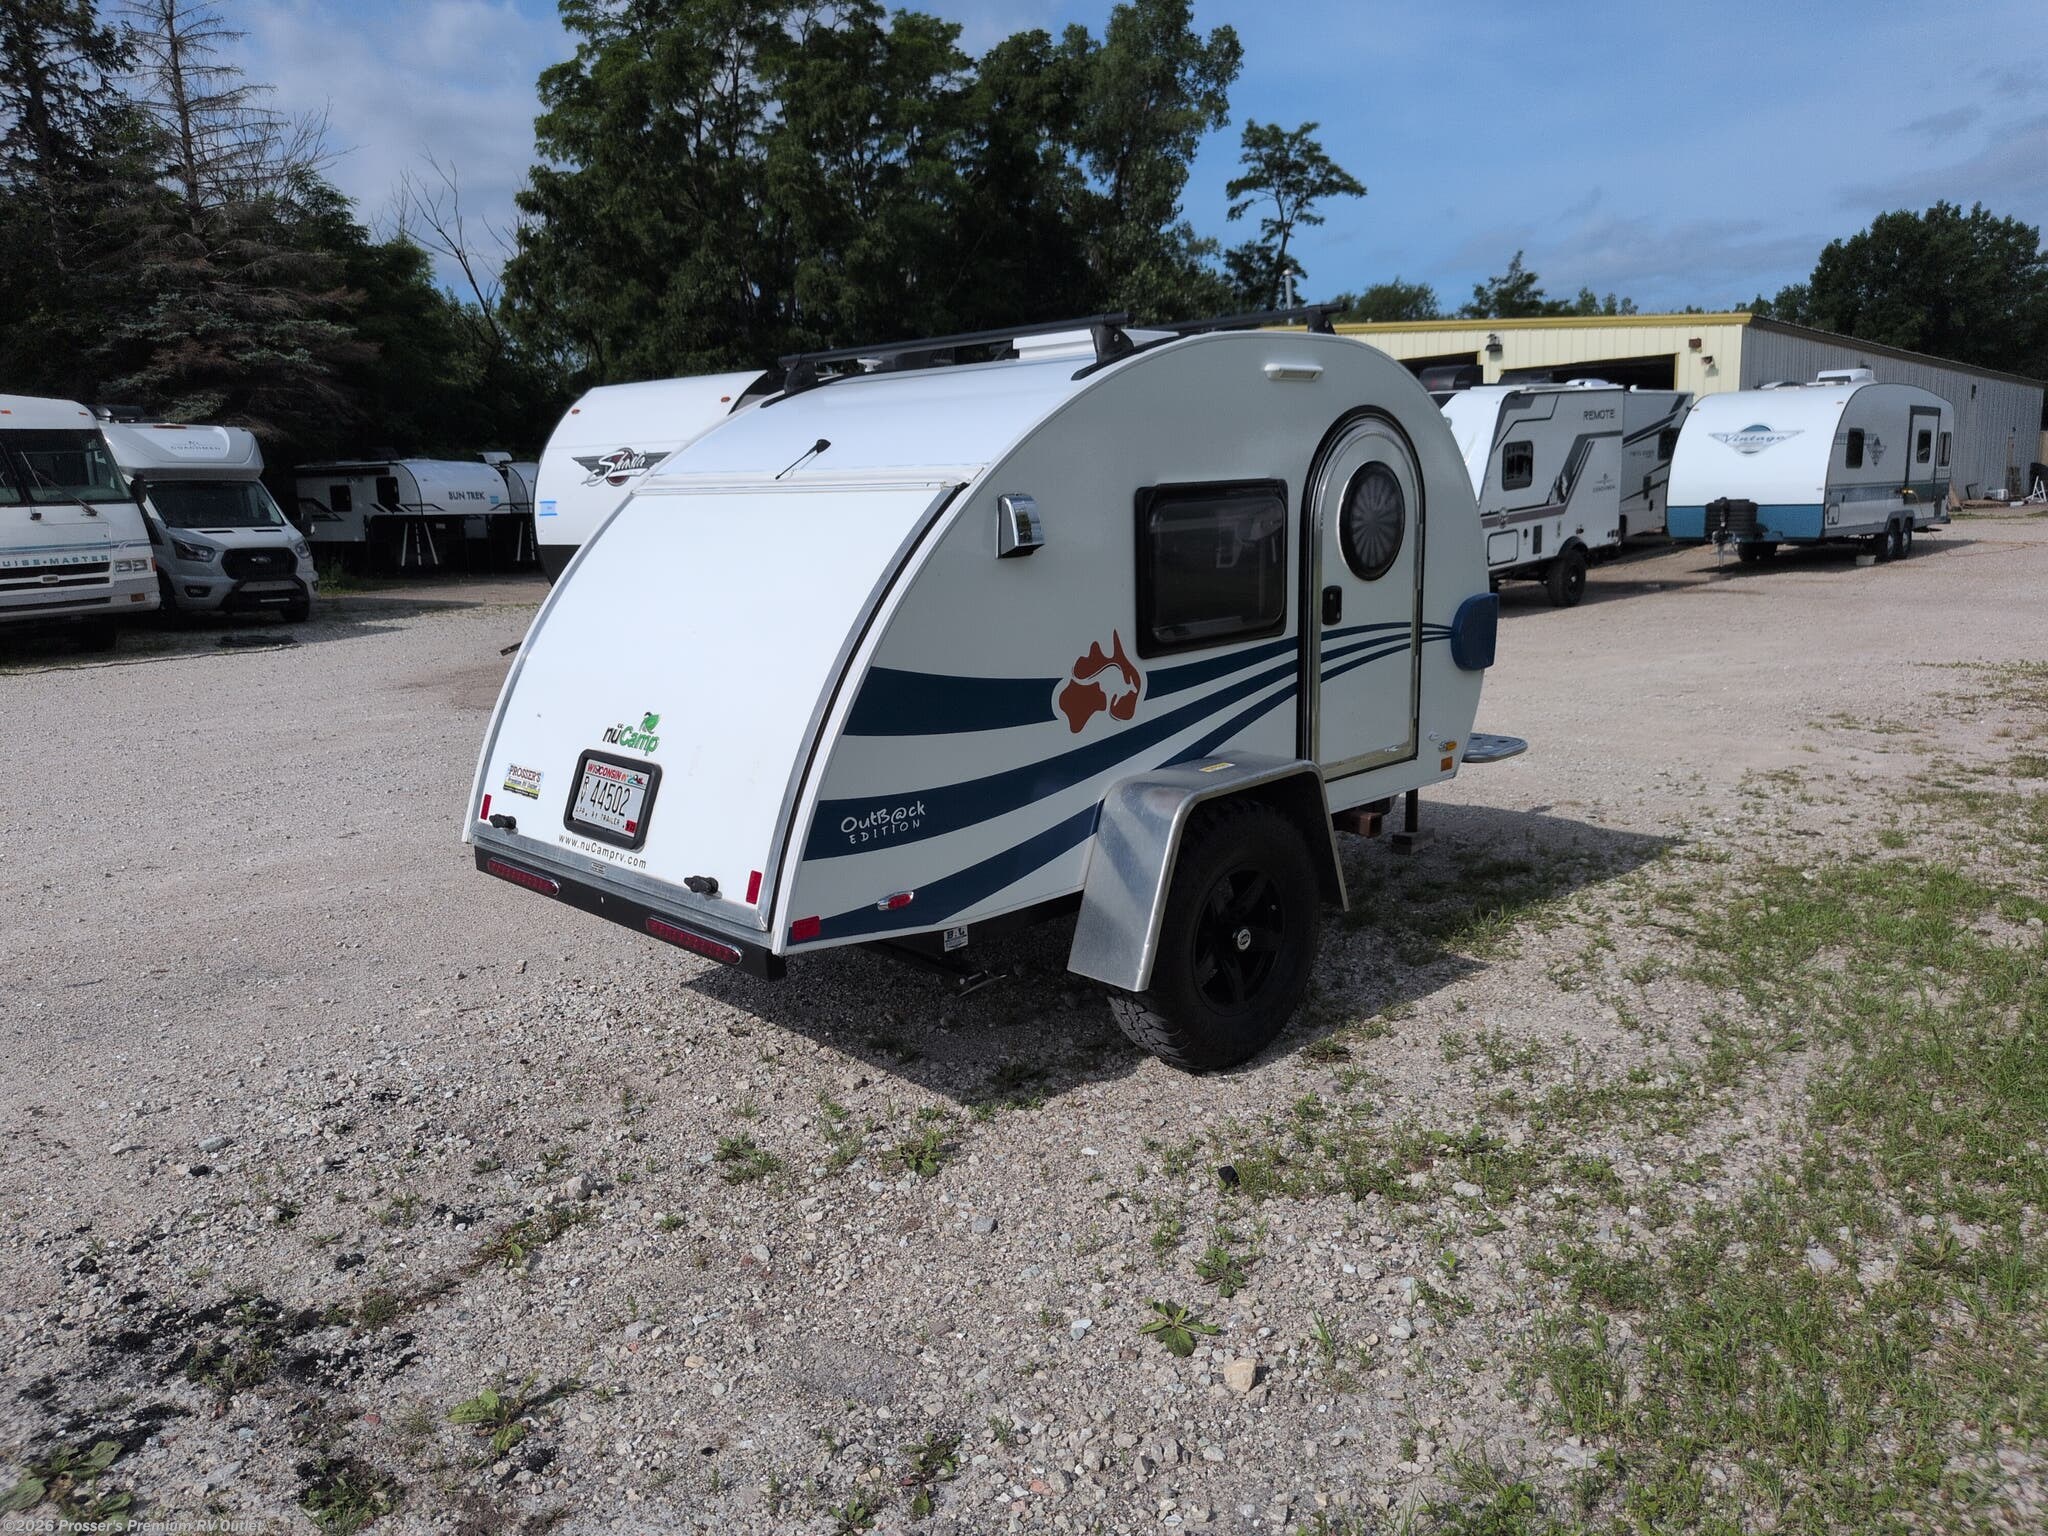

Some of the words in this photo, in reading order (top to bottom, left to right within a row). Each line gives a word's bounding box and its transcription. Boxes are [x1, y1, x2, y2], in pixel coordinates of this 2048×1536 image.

[1583, 409, 1616, 420] REMOTE
[1722, 432, 1786, 444] Vintage
[448, 490, 466, 501] SUN
[466, 490, 486, 501] TREK
[587, 762, 622, 780] WISCONSIN
[590, 779, 631, 817] 44502
[849, 819, 920, 844] EDITION
[559, 834, 647, 870] www.nuCamprv.com
